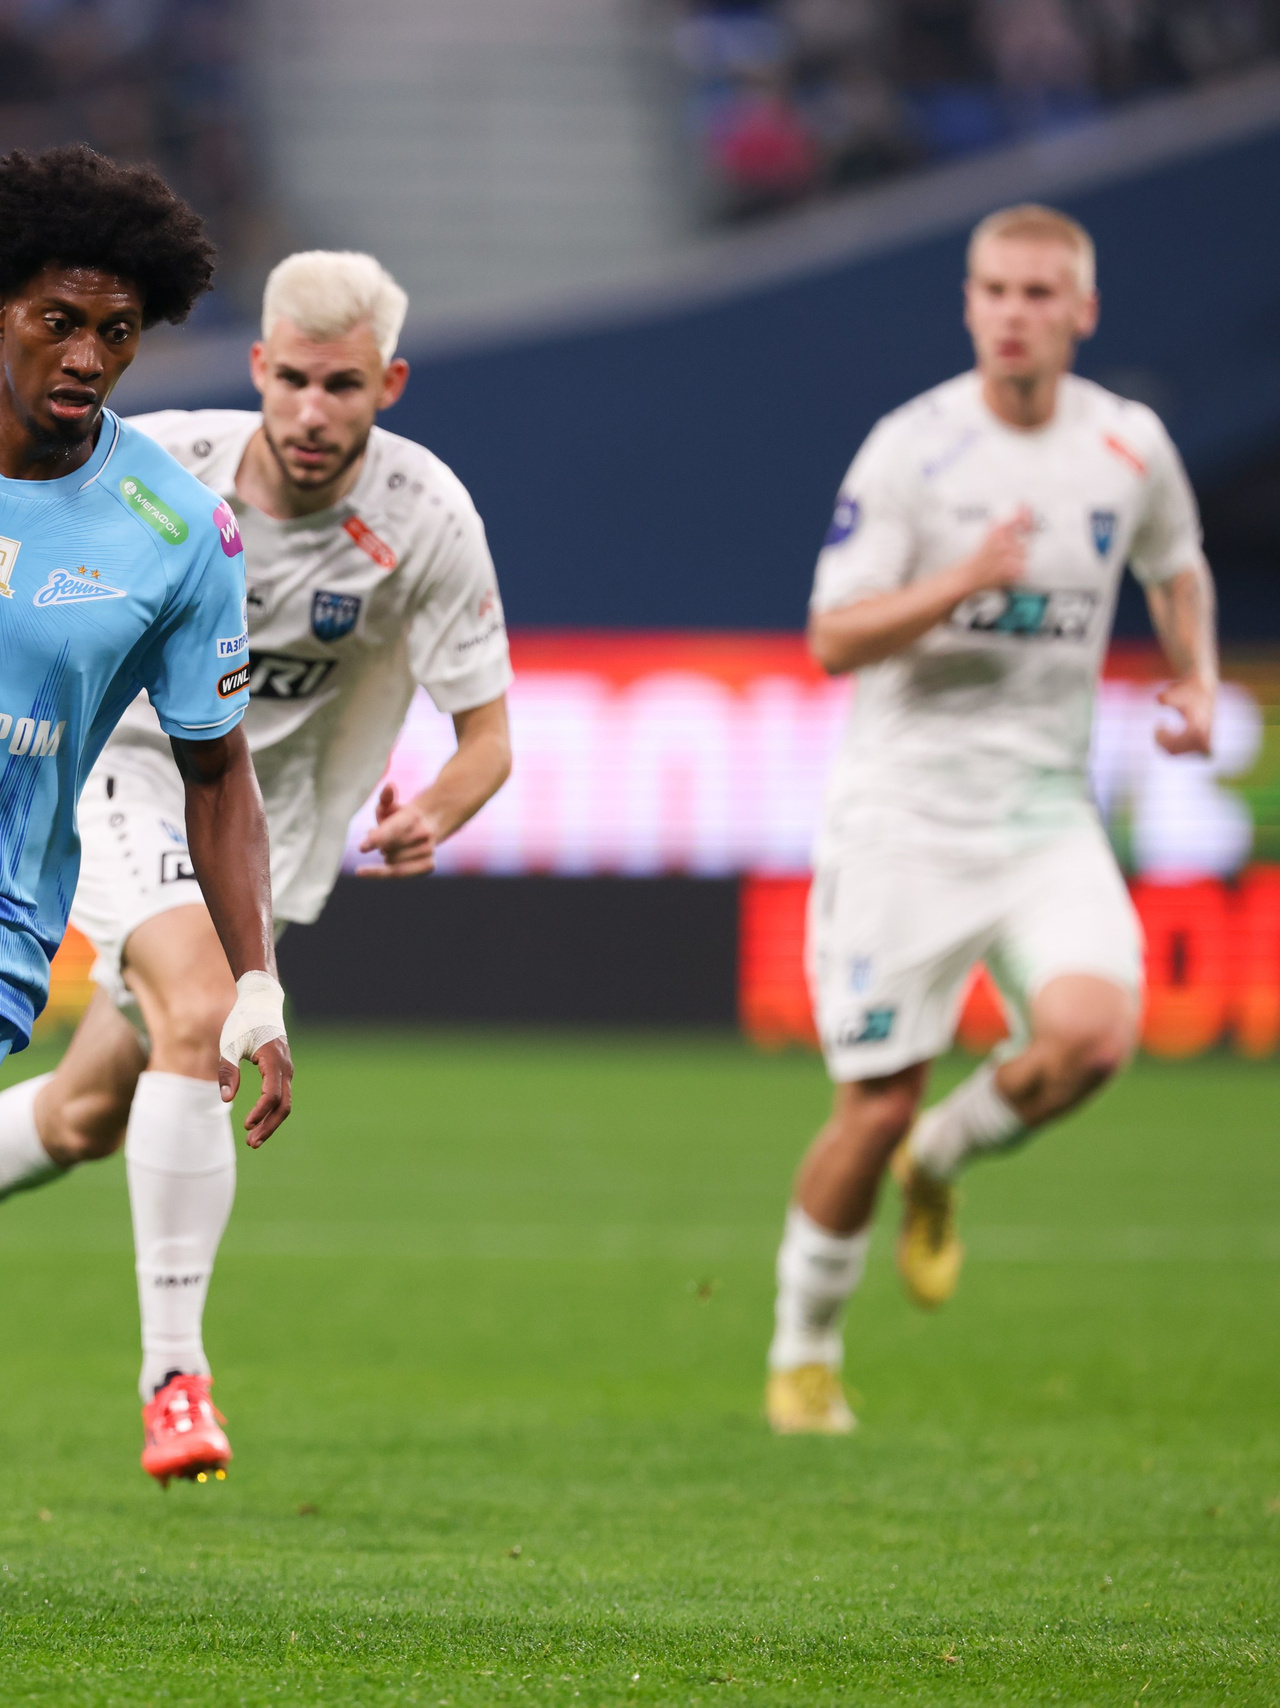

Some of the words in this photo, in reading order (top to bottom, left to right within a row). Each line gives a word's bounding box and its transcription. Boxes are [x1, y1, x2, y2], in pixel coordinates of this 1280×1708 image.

[134, 493, 181, 538] МЕГАФОН
[222, 667, 249, 694] WINL
[249, 659, 328, 697] RI
